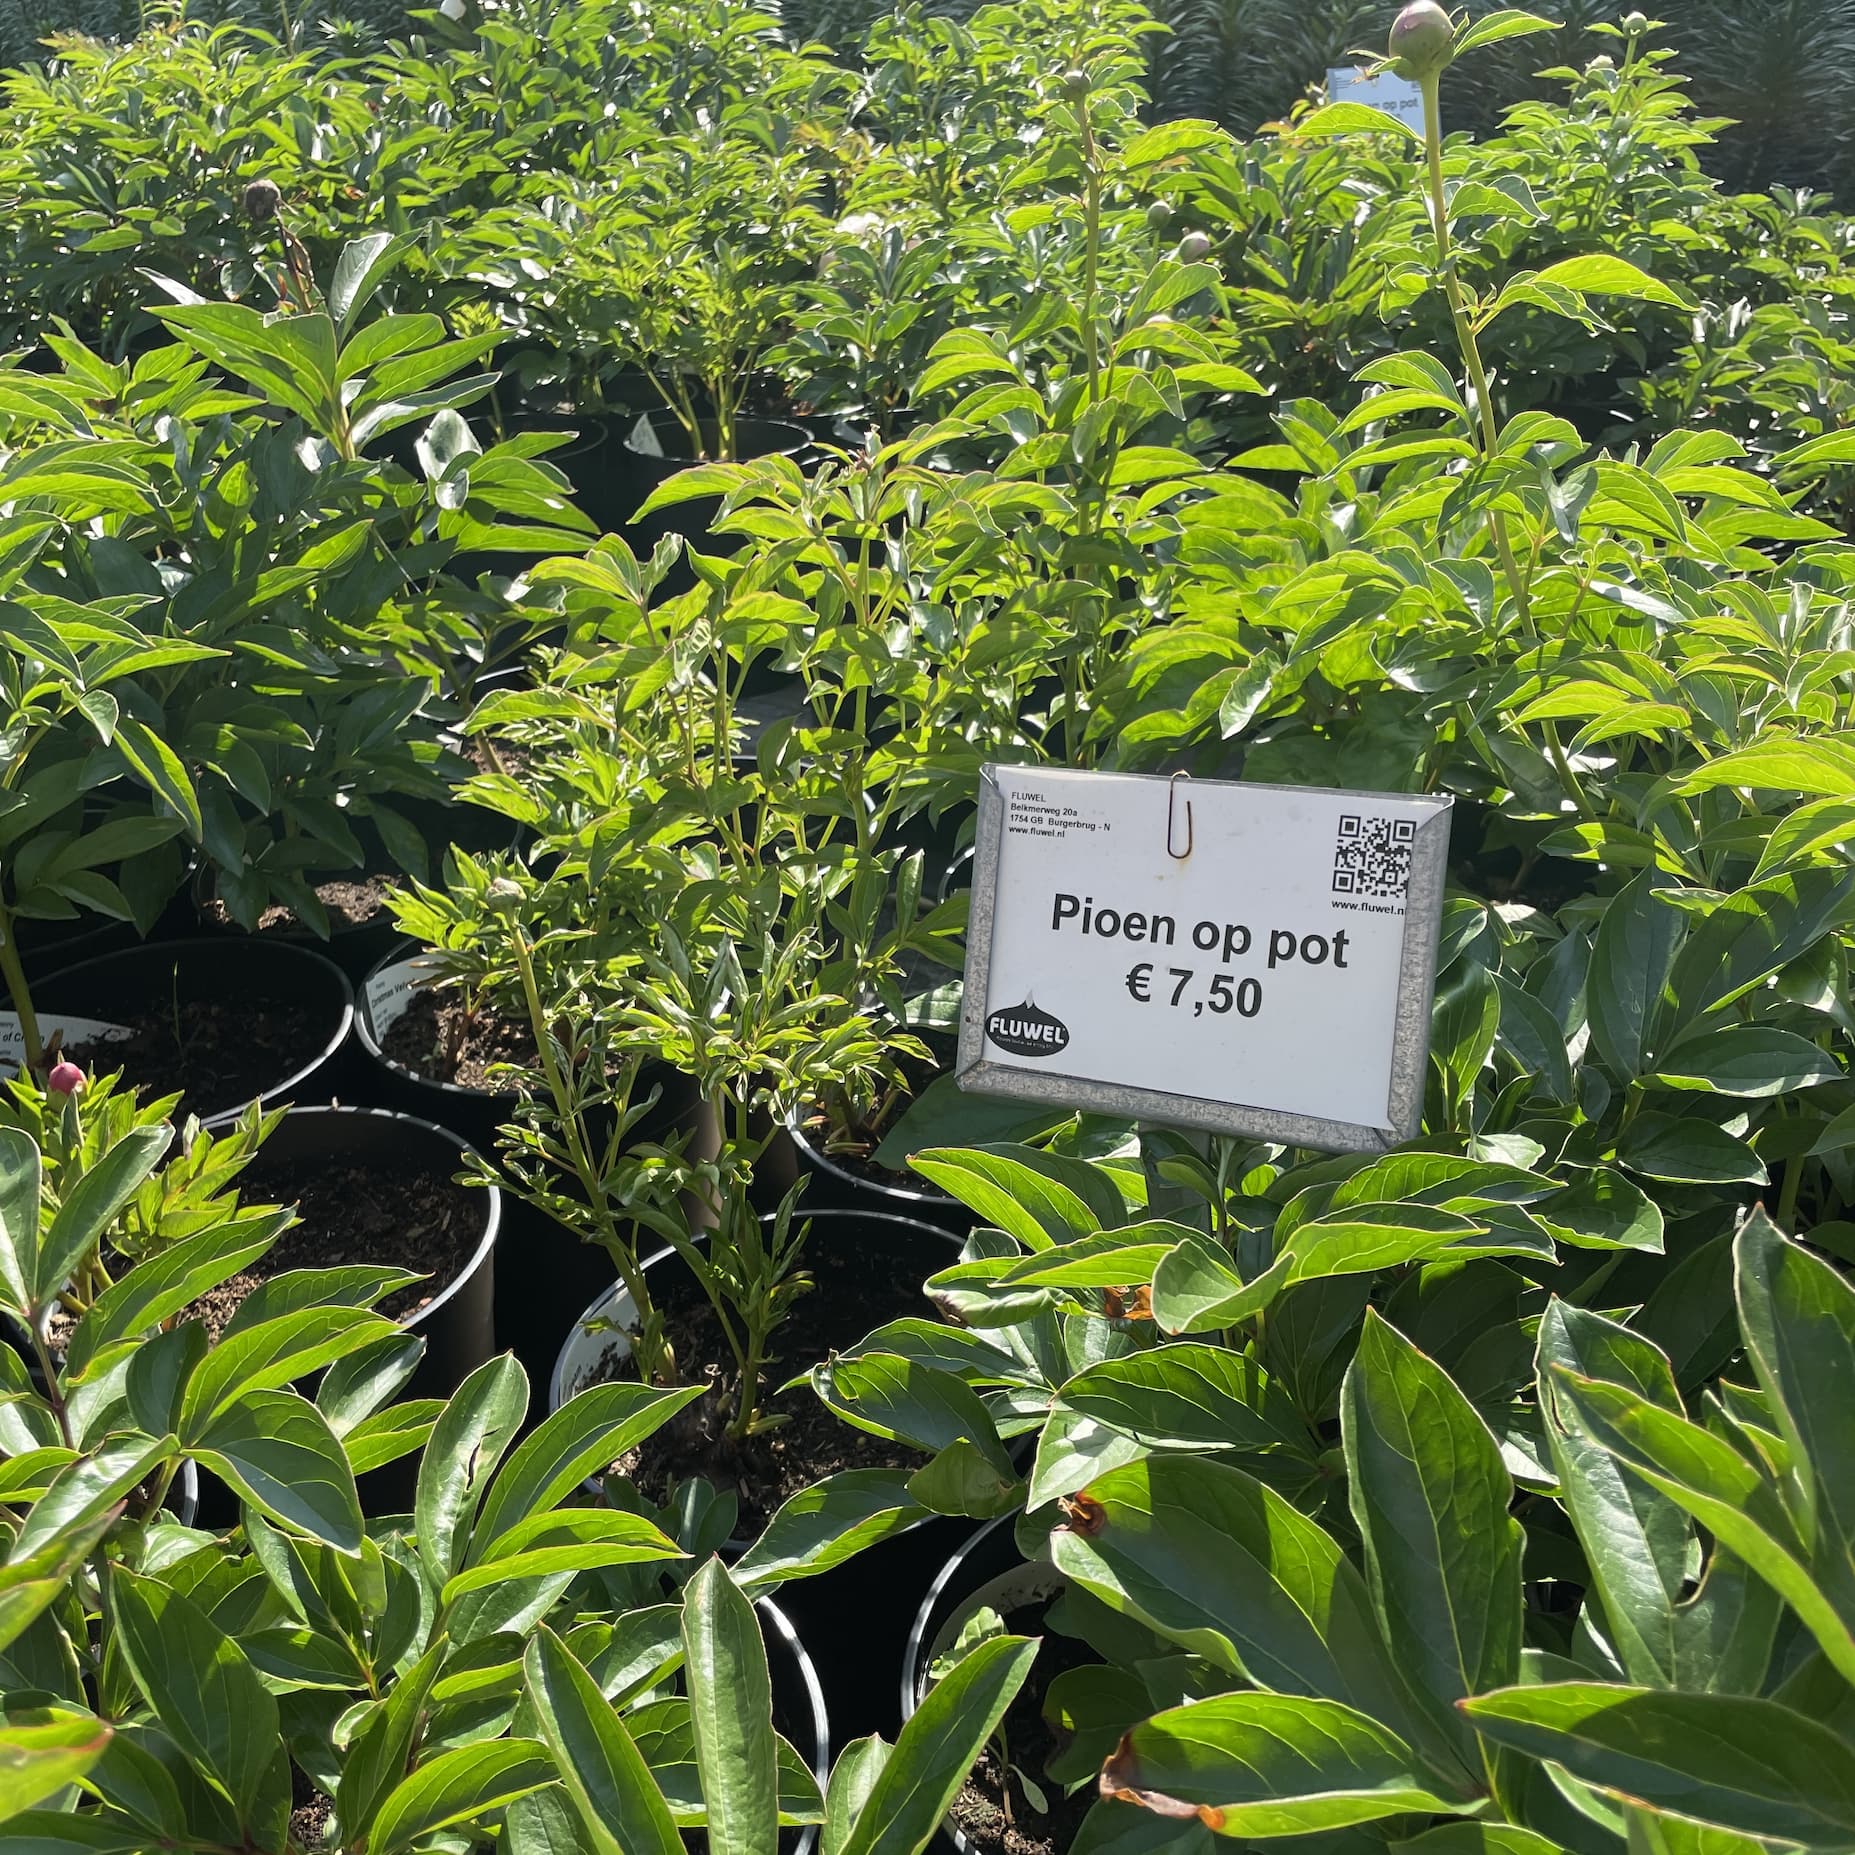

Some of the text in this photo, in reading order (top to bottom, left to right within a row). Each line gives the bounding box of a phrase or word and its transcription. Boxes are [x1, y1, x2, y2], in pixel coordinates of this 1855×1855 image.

[1400, 97, 1419, 111] pot
[1011, 791, 1047, 802] FLUWEL
[1010, 802, 1078, 817] Belkmerweg 20a
[1010, 813, 1029, 823] 1754
[1030, 816, 1044, 825] GB
[1048, 817, 1096, 832] Burgerbrug
[1103, 823, 1111, 832] N
[1008, 826, 1065, 838] www.fluwel.nl
[1052, 893, 1350, 969] Pioen op pot
[1125, 962, 1263, 1018] € 7,50
[989, 1016, 1065, 1045] FLUWEL
